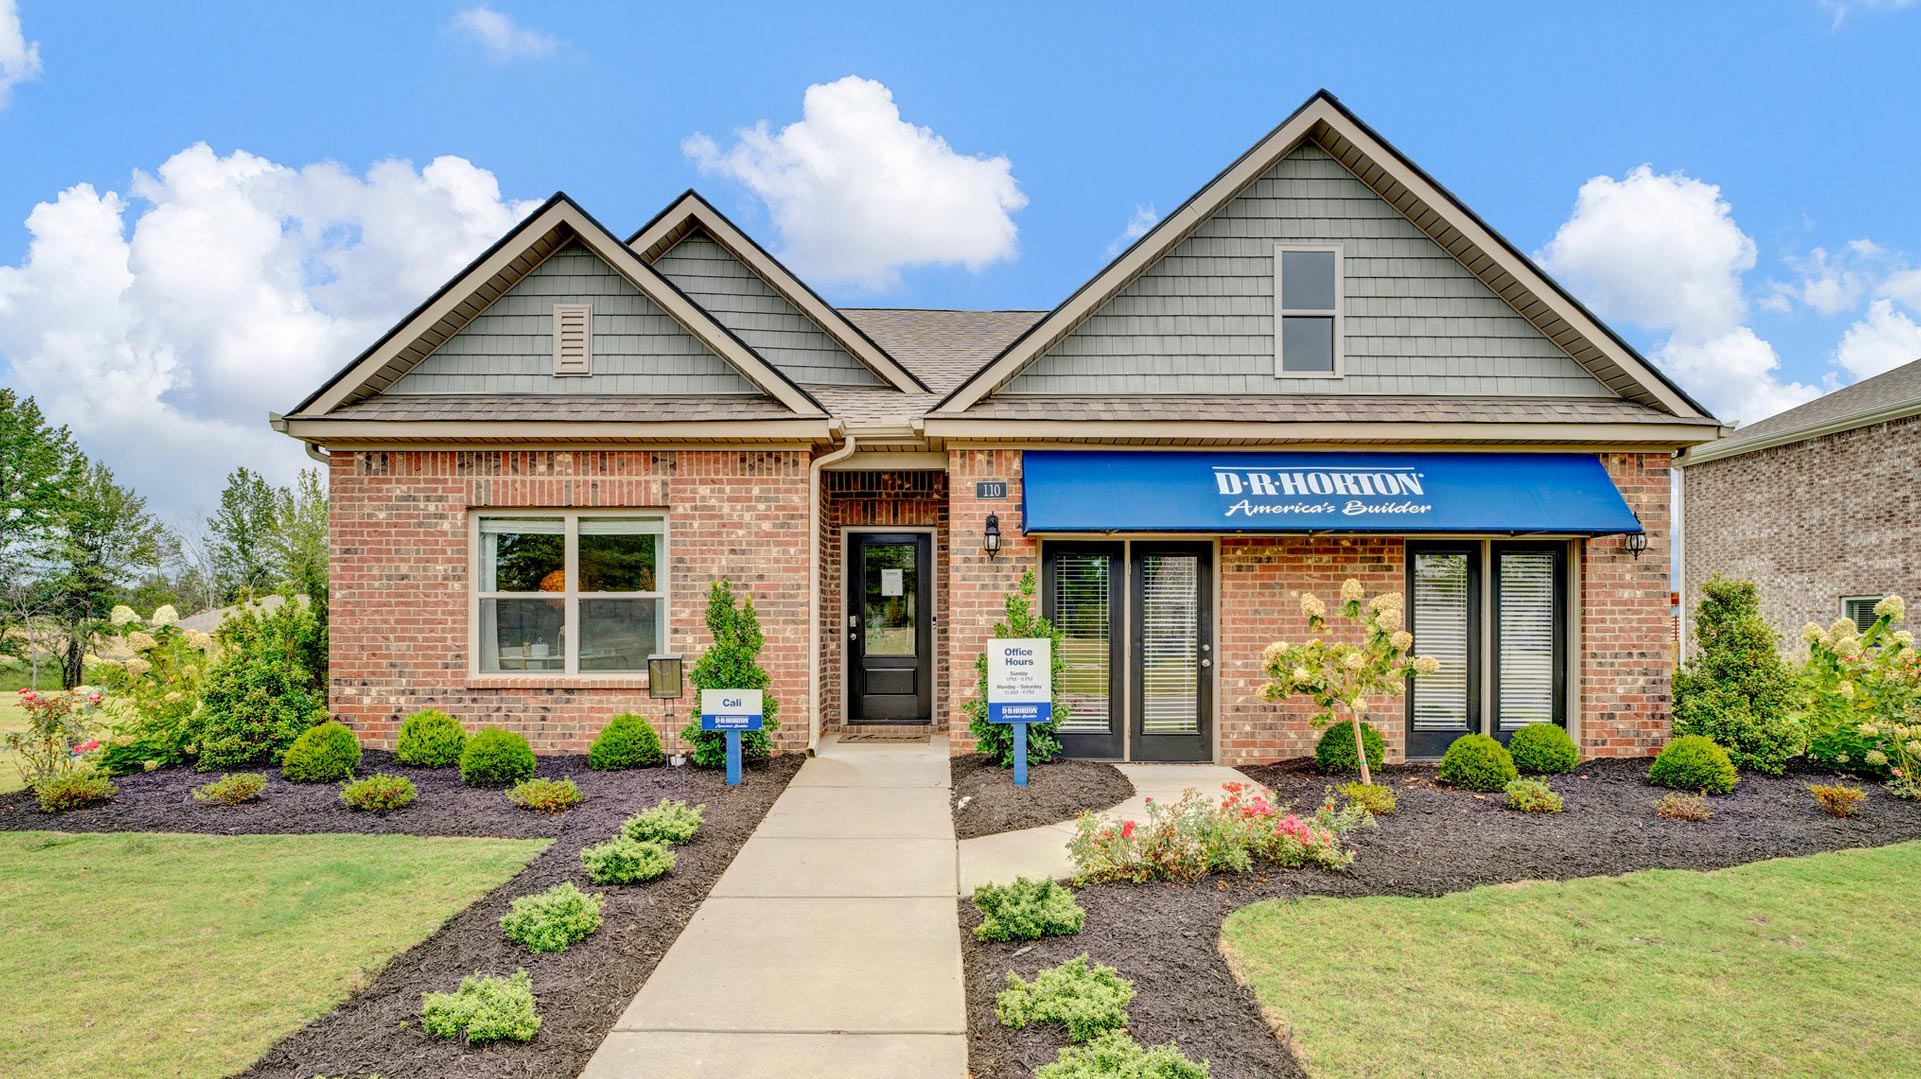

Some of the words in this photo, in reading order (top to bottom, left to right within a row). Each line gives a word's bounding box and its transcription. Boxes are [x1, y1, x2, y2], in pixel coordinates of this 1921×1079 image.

[983, 484, 1001, 497] 110
[1224, 499, 1336, 517] America's
[1341, 500, 1431, 516] Builder
[1004, 647, 1033, 656] Office
[1005, 657, 1034, 666] Hours
[722, 698, 742, 707] Cali
